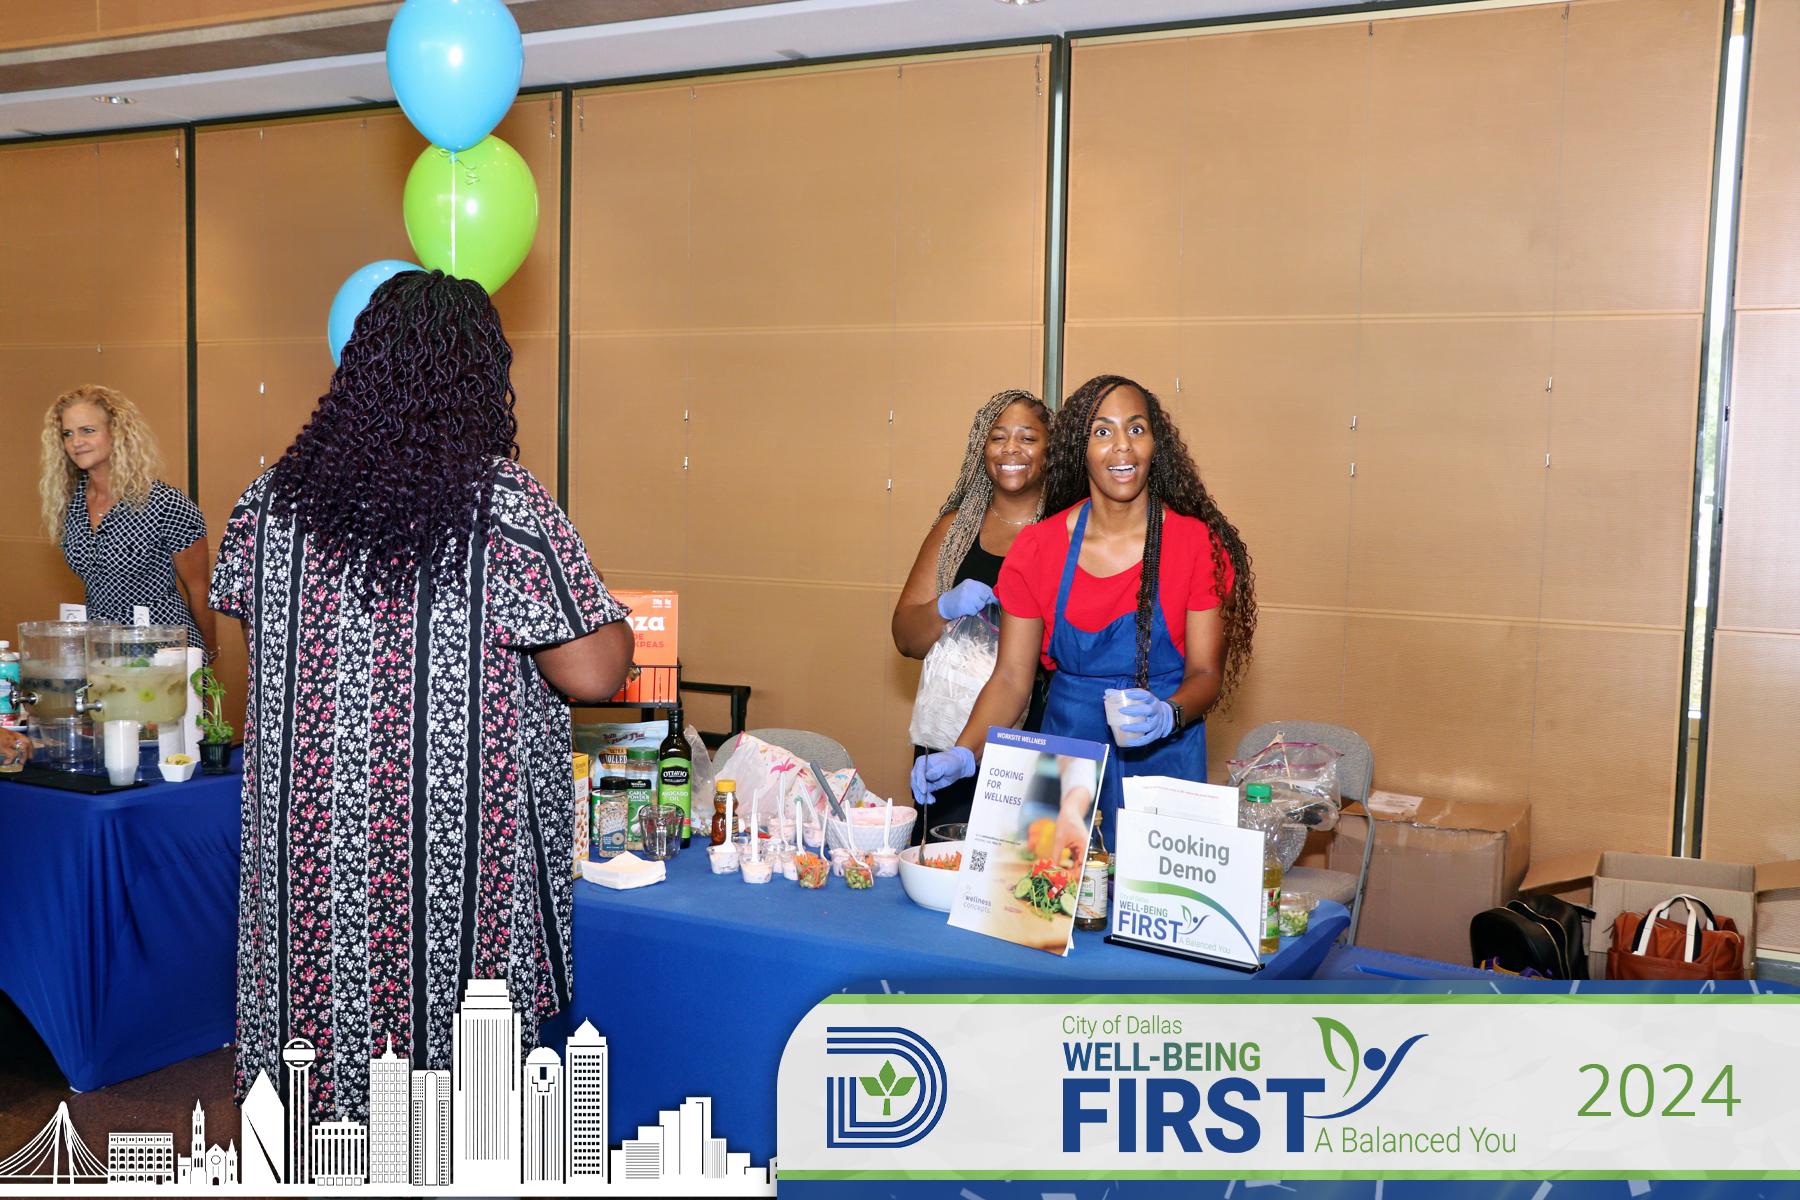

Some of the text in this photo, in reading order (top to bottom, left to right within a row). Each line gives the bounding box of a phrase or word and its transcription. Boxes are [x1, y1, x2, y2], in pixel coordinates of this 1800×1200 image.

[635, 640, 665, 648] KPEAS
[996, 732, 1047, 746] WORKSITE WELLNESS
[606, 754, 628, 764] OLLED
[989, 767, 1025, 781] COOKING
[986, 779, 1002, 790] FOR
[984, 791, 1022, 806] WELLNESS
[1148, 829, 1230, 866] Cooking
[1159, 855, 1217, 884] Demo
[965, 895, 992, 907] wellness
[1119, 900, 1169, 917] WELL-BEING
[1118, 910, 1183, 943] FIRST
[1178, 937, 1231, 954] A Balanced You
